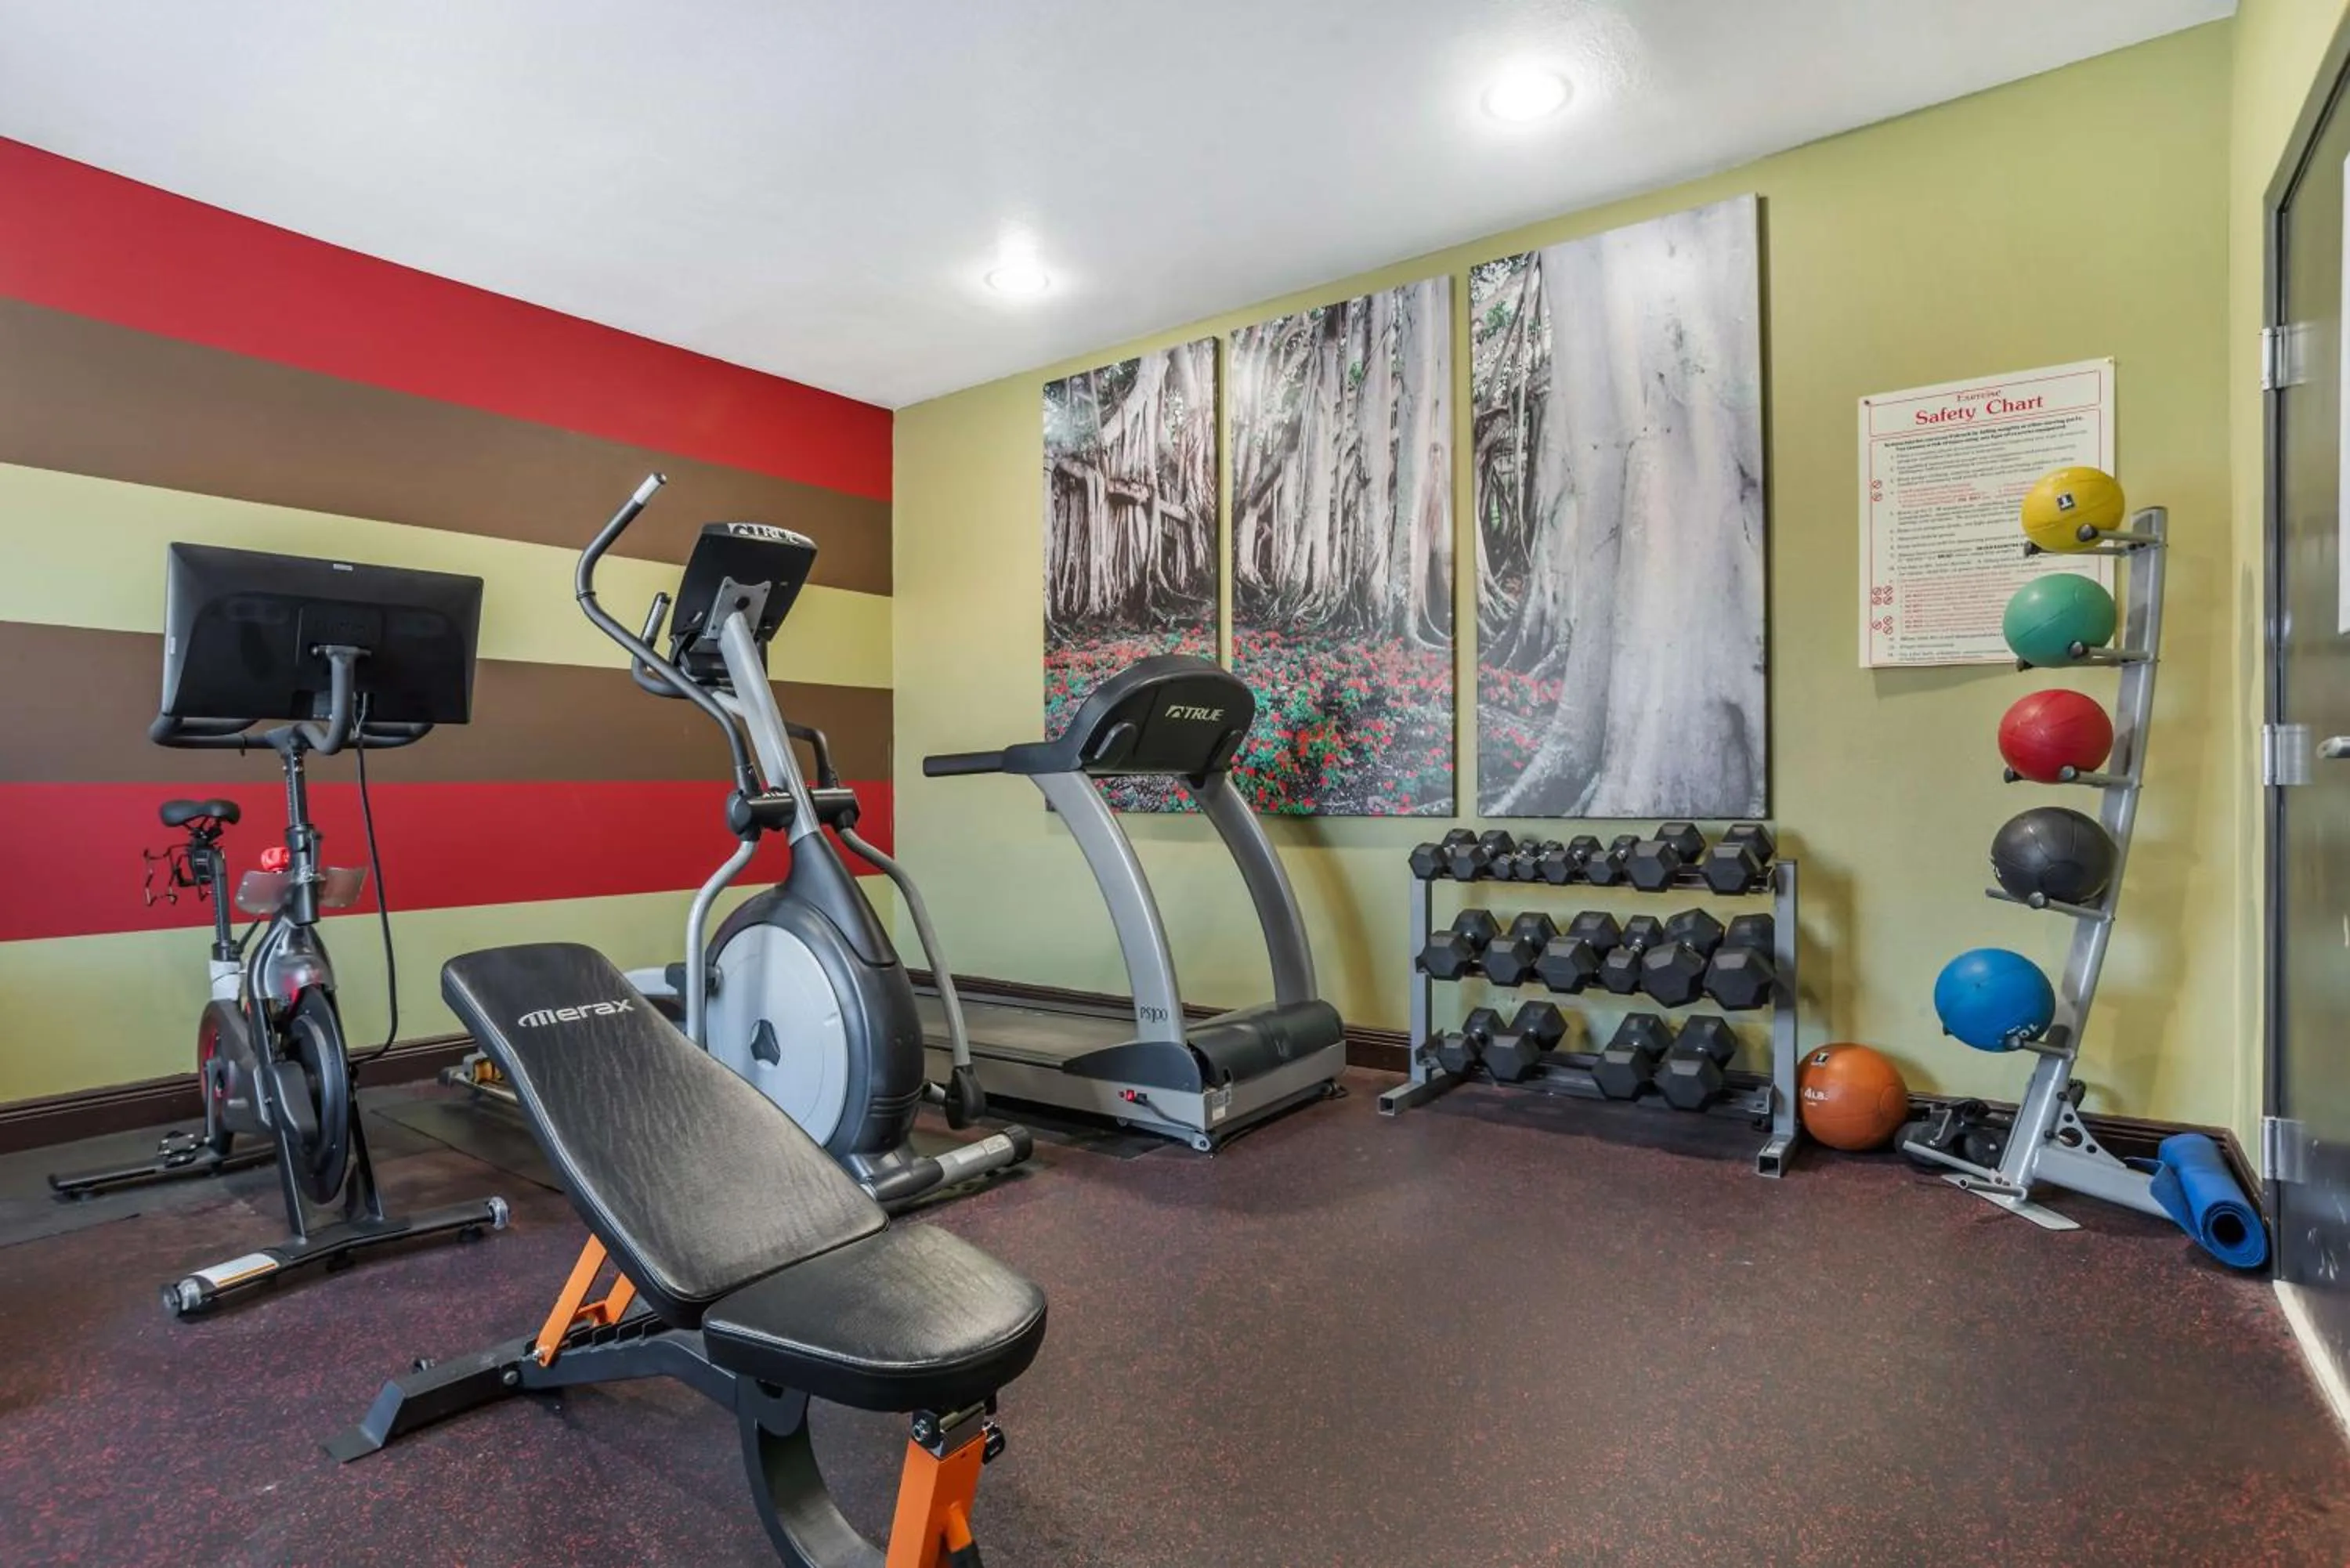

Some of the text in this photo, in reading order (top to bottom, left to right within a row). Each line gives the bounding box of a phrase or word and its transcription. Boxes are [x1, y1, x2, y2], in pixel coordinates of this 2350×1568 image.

[1915, 396, 2044, 425] Safety Chart
[1184, 706, 1225, 721] TRUE
